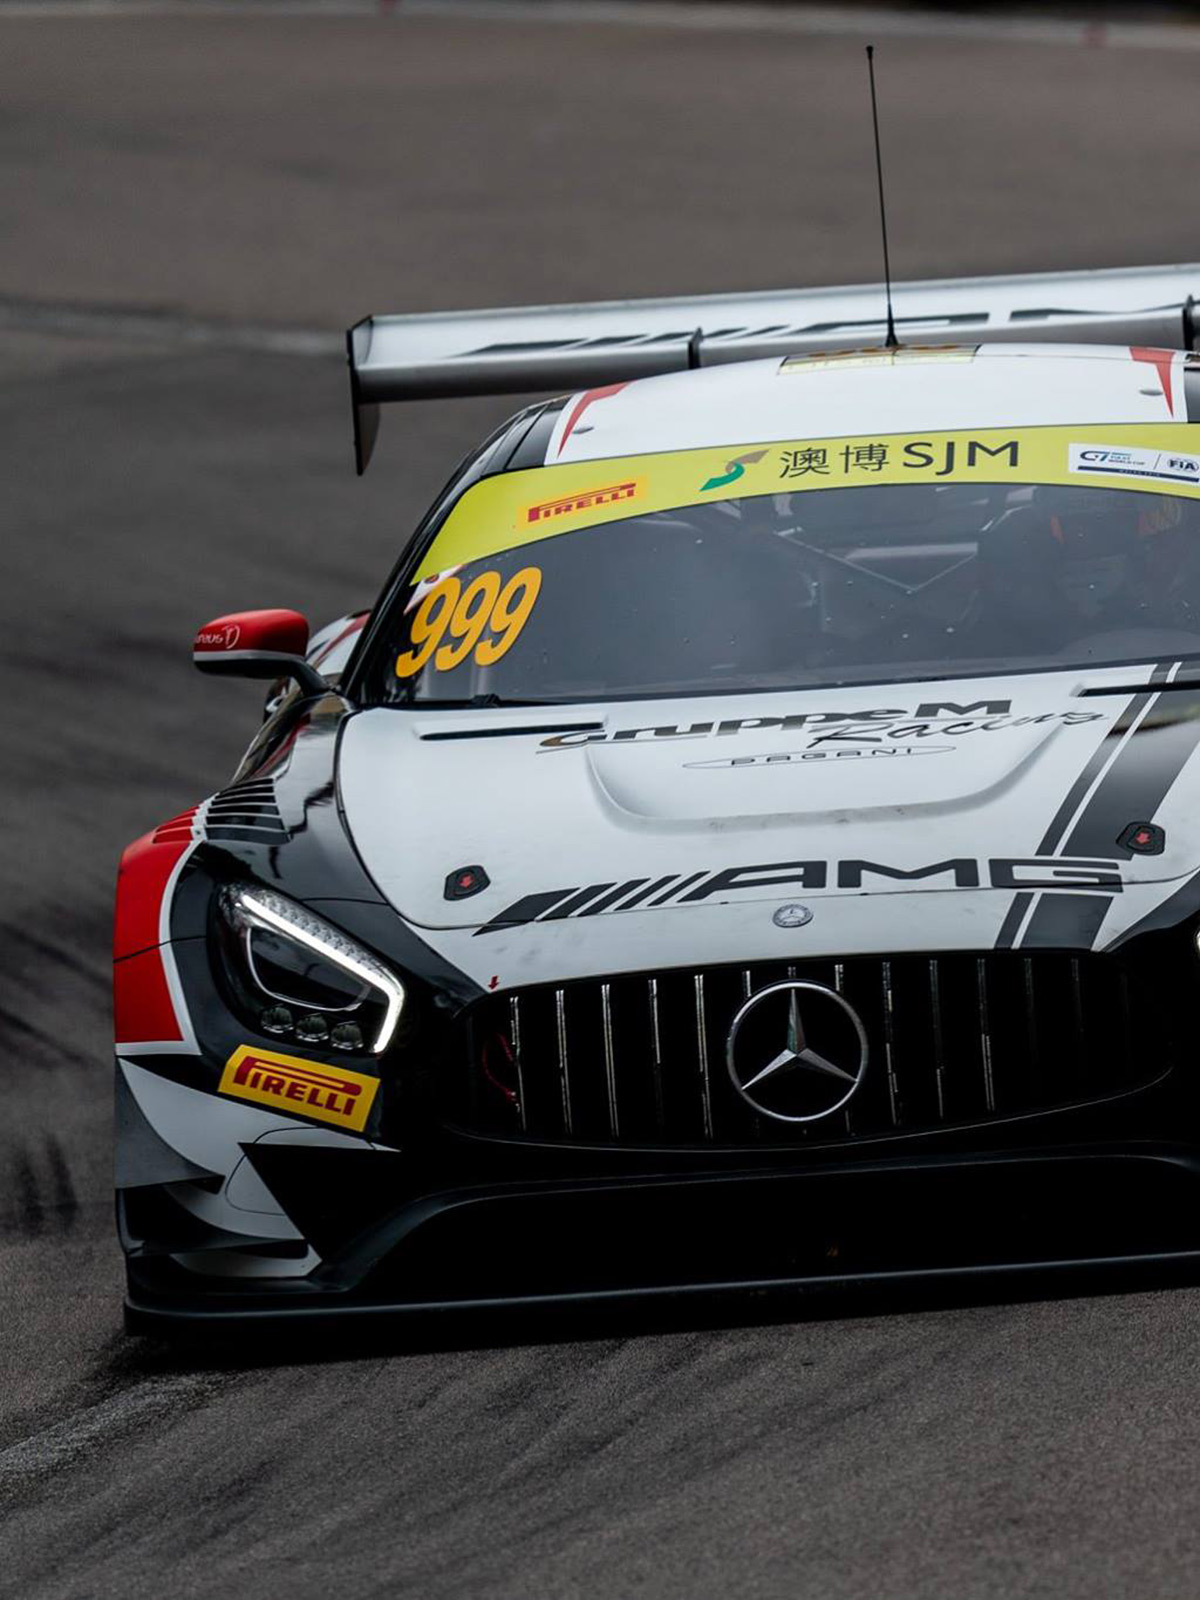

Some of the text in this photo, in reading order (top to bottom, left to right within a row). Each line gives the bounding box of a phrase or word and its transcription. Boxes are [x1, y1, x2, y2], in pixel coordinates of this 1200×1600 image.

[779, 440, 1019, 479] 澳博 SJM
[1168, 458, 1198, 471] FIA
[528, 482, 637, 523] PIRELLI
[395, 566, 543, 679] 999
[806, 711, 1109, 748] Racing
[731, 747, 912, 766] PAGANI
[678, 857, 1124, 903] AMG
[233, 1055, 363, 1116] PIRELLI
